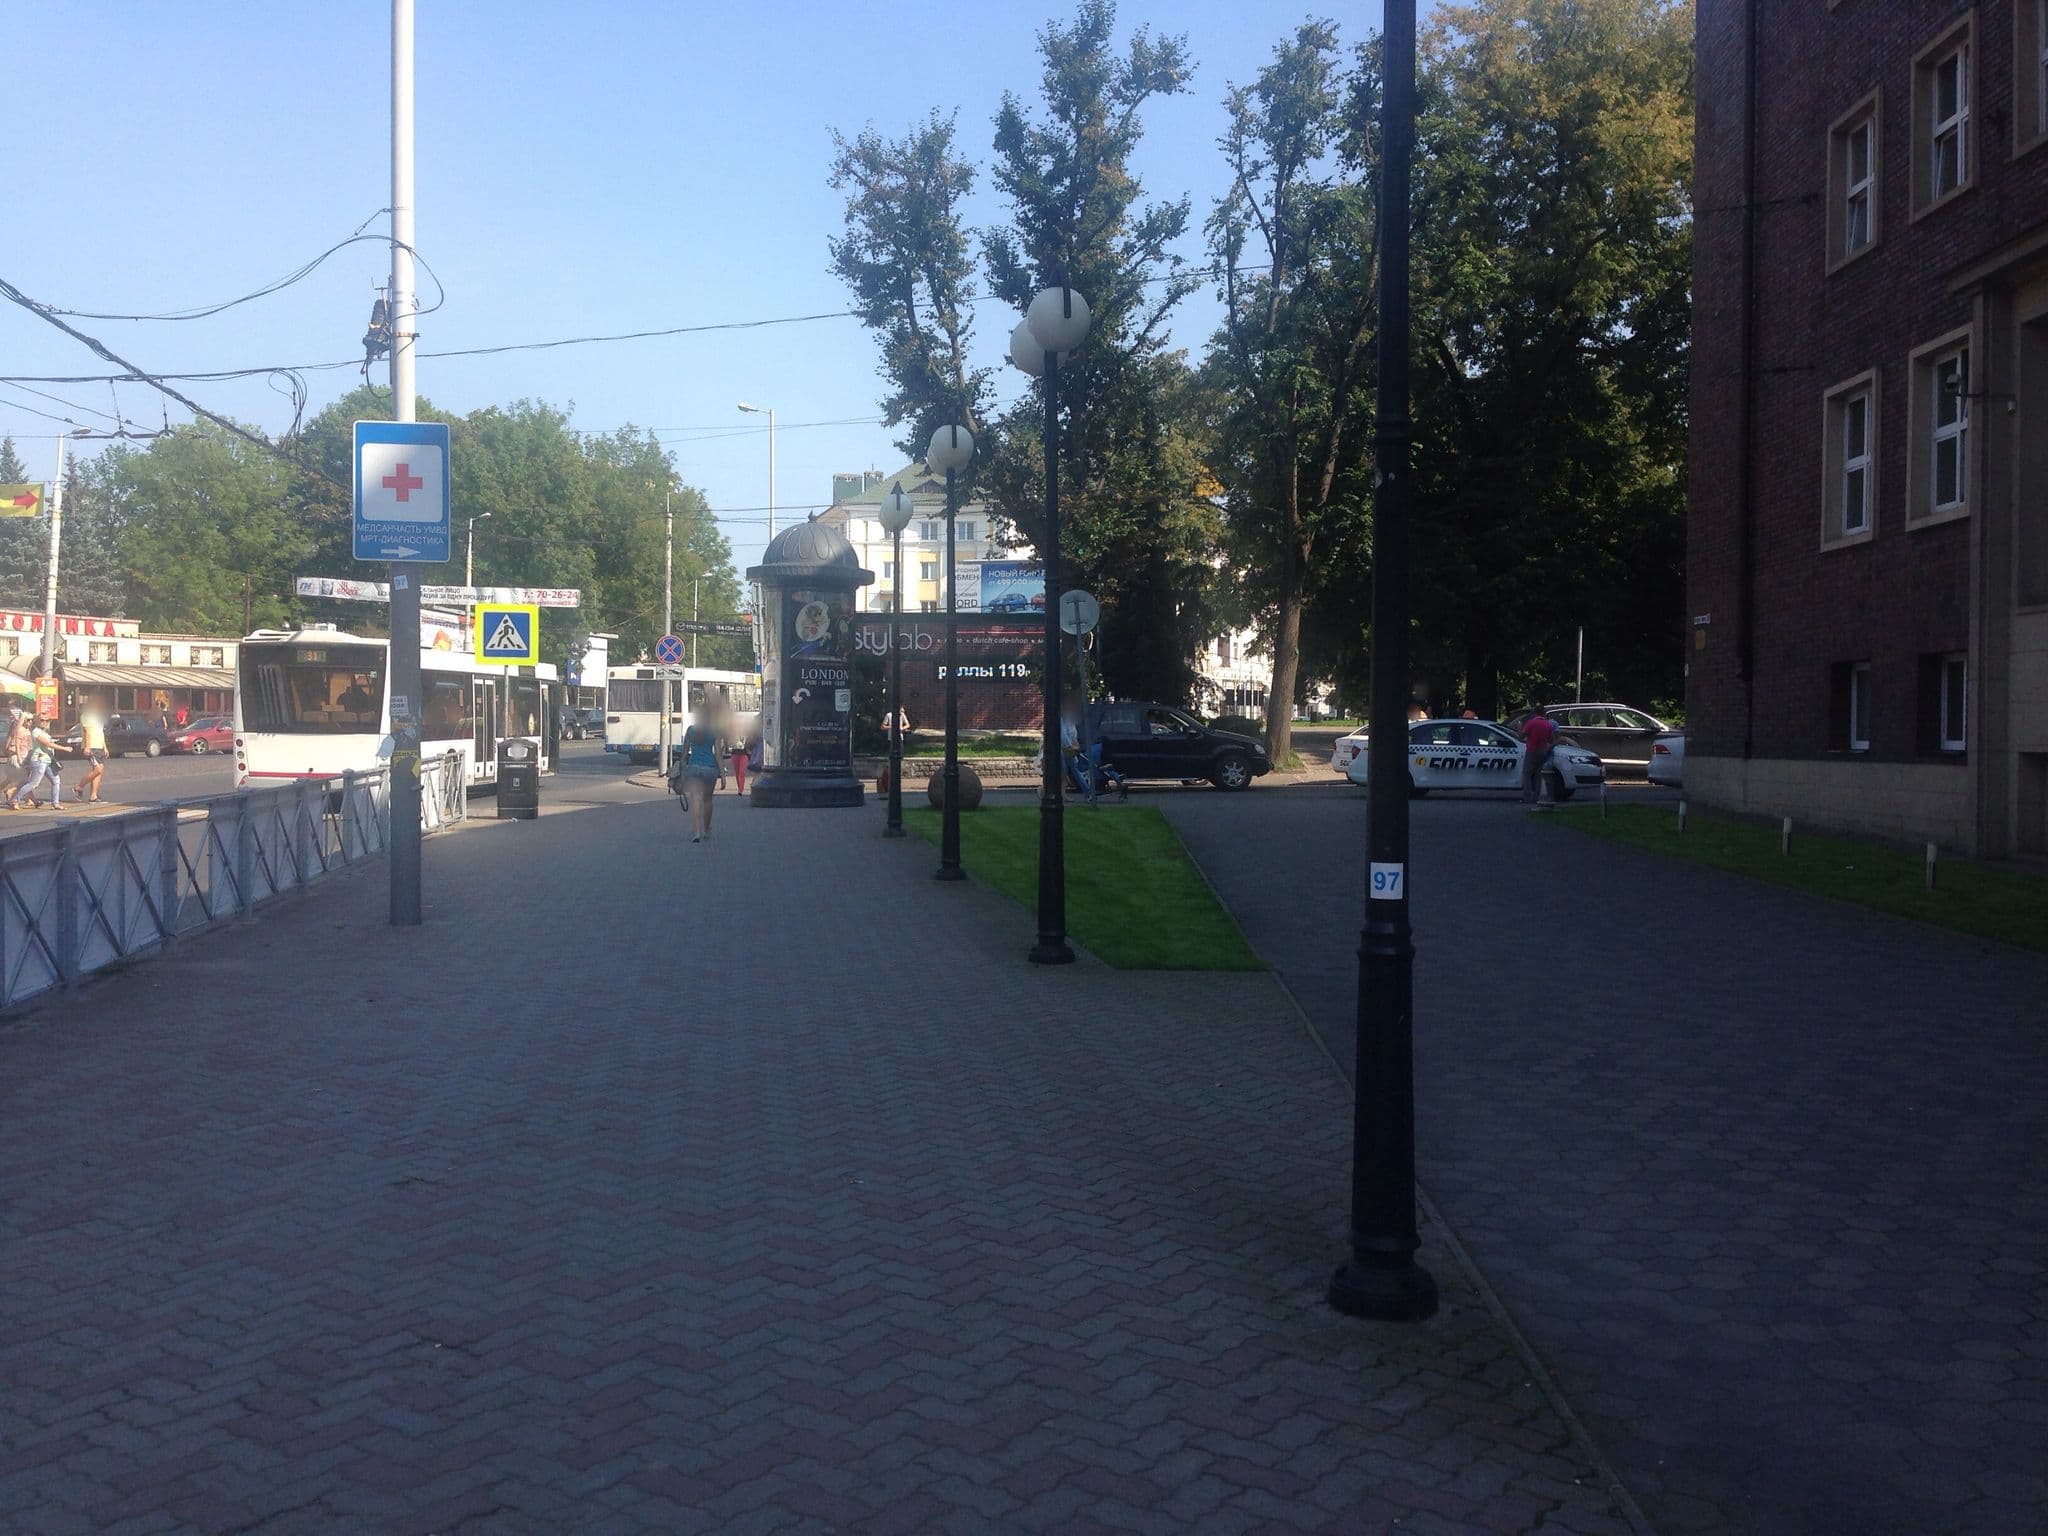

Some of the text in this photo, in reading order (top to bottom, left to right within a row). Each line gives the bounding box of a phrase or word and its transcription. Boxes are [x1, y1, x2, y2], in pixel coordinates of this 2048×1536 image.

[357, 523, 448, 535] МЕДСАНЧАСТЬ УМВД
[361, 534, 444, 545] МРТ-ДИАГНОСТИКА
[956, 573, 979, 581] БМЕН
[988, 568, 1018, 578] НОВЫЙ
[536, 590, 579, 600] 70-26-24
[956, 599, 978, 609] ORD
[801, 668, 849, 681] LONDON
[938, 665, 993, 679] рллы
[1373, 871, 1400, 891] 97
